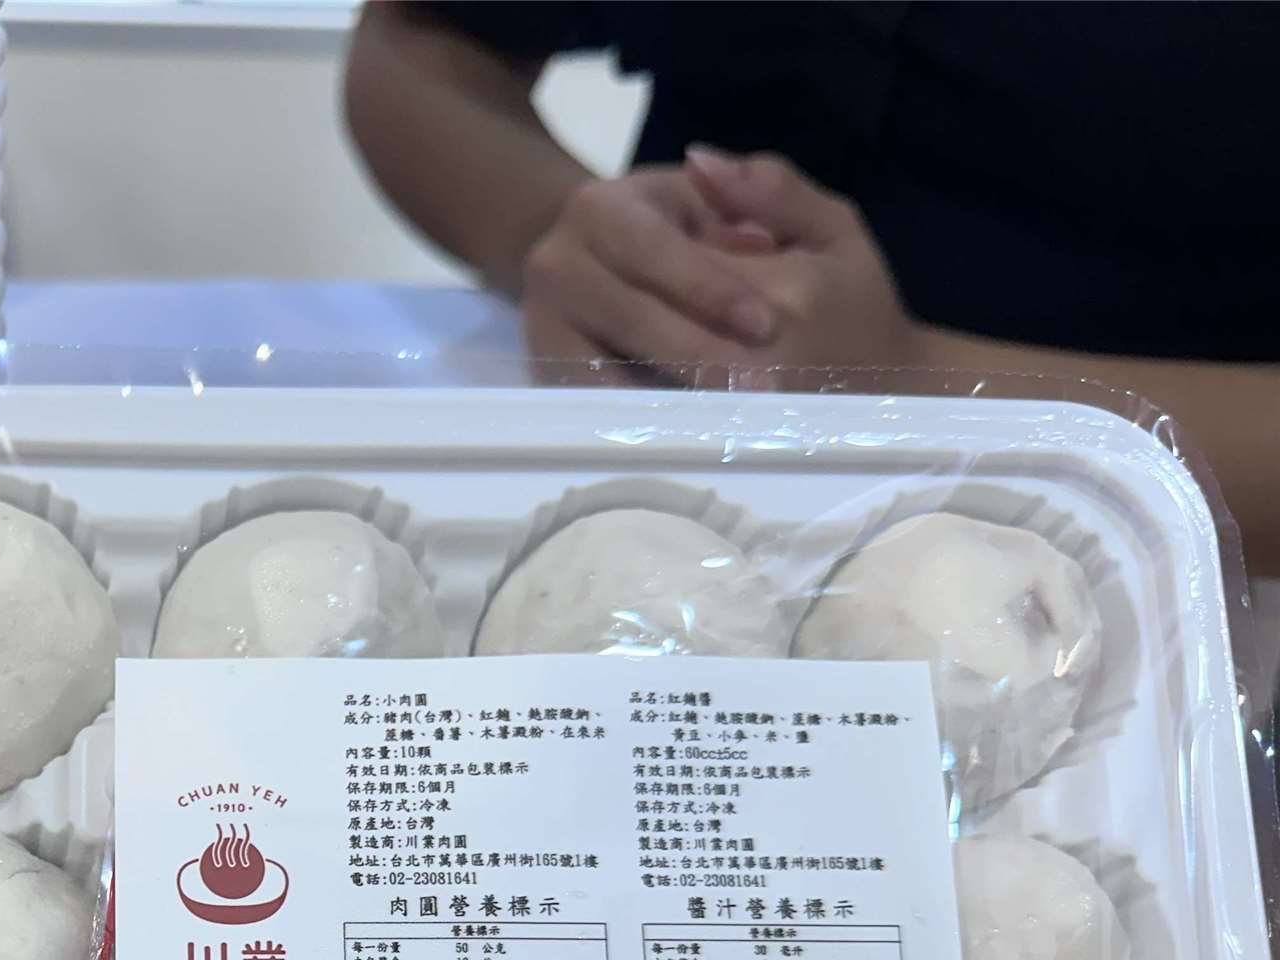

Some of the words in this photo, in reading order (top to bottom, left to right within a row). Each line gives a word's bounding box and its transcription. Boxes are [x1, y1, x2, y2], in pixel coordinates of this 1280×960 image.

[344, 693, 428, 707] 品名:小肉圓
[346, 762, 528, 777] 有效日期:依商品包裝標示
[346, 781, 456, 794] 保存期限:6個月
[177, 783, 239, 807] CHUAN
[252, 785, 287, 808] YEH
[217, 804, 246, 812] 1910
[347, 799, 451, 812] 保存方式:冷凍
[634, 801, 736, 814] 保存方式:冷凍
[348, 817, 434, 830] 原產地:台灣
[636, 819, 721, 833] 原產地:台灣
[349, 834, 467, 849] 製造商:川業肉圓
[350, 872, 477, 886] 電話:02-23081641
[641, 874, 766, 888] 電話:02-23081641
[390, 895, 560, 917] 肉圓營養標示
[687, 897, 854, 919] 醬汁營養標示
[451, 926, 500, 936] 營養標示
[352, 942, 400, 953] 每一份量
[456, 943, 468, 953] 50
[482, 943, 506, 954] 公克
